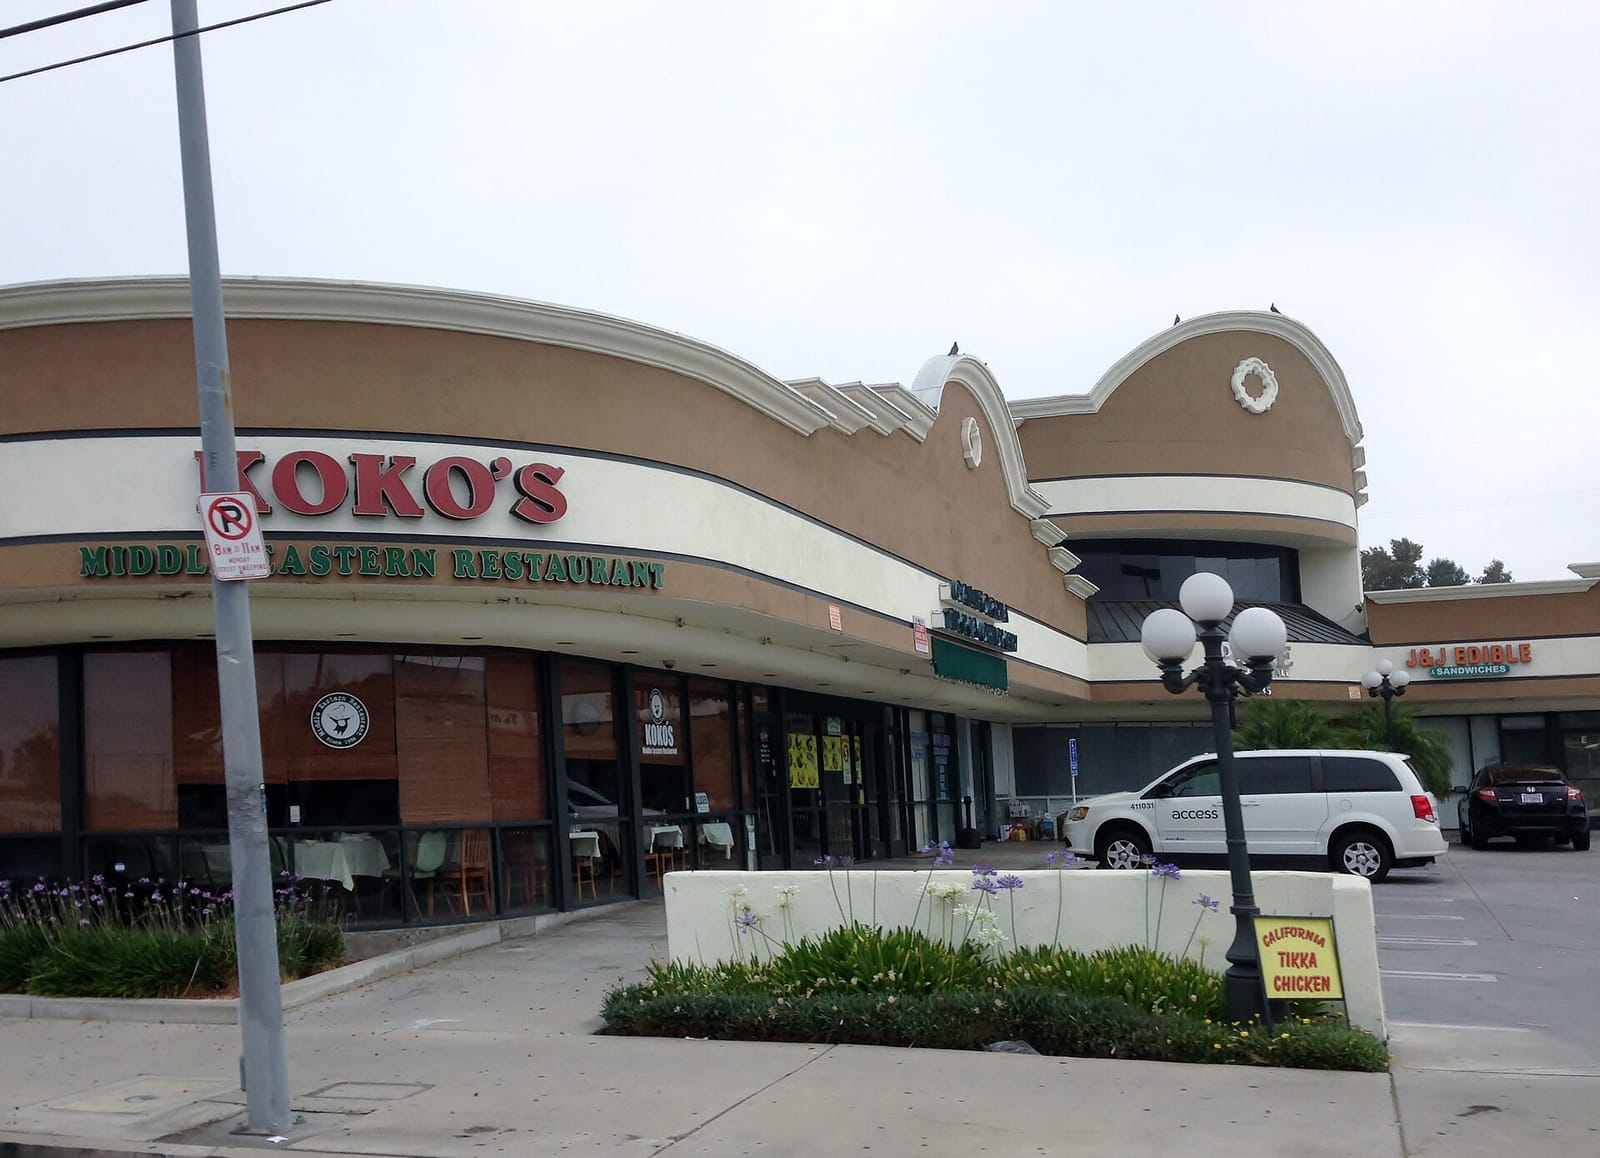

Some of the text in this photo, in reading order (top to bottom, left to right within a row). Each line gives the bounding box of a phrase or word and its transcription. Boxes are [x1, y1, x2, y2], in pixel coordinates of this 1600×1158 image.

[194, 450, 568, 524] KOKO'S
[79, 544, 208, 576] MIDDL
[452, 548, 665, 590] RESTAURANT
[1406, 643, 1532, 668] J&J EDIBLE
[1436, 665, 1506, 676] SANDWICHES
[1130, 802, 1154, 810] 411031
[1172, 810, 1219, 819] access
[1262, 926, 1326, 948] CALIFORNIA
[1277, 951, 1318, 969] TIKKA
[1273, 975, 1331, 992] CHICKEN
